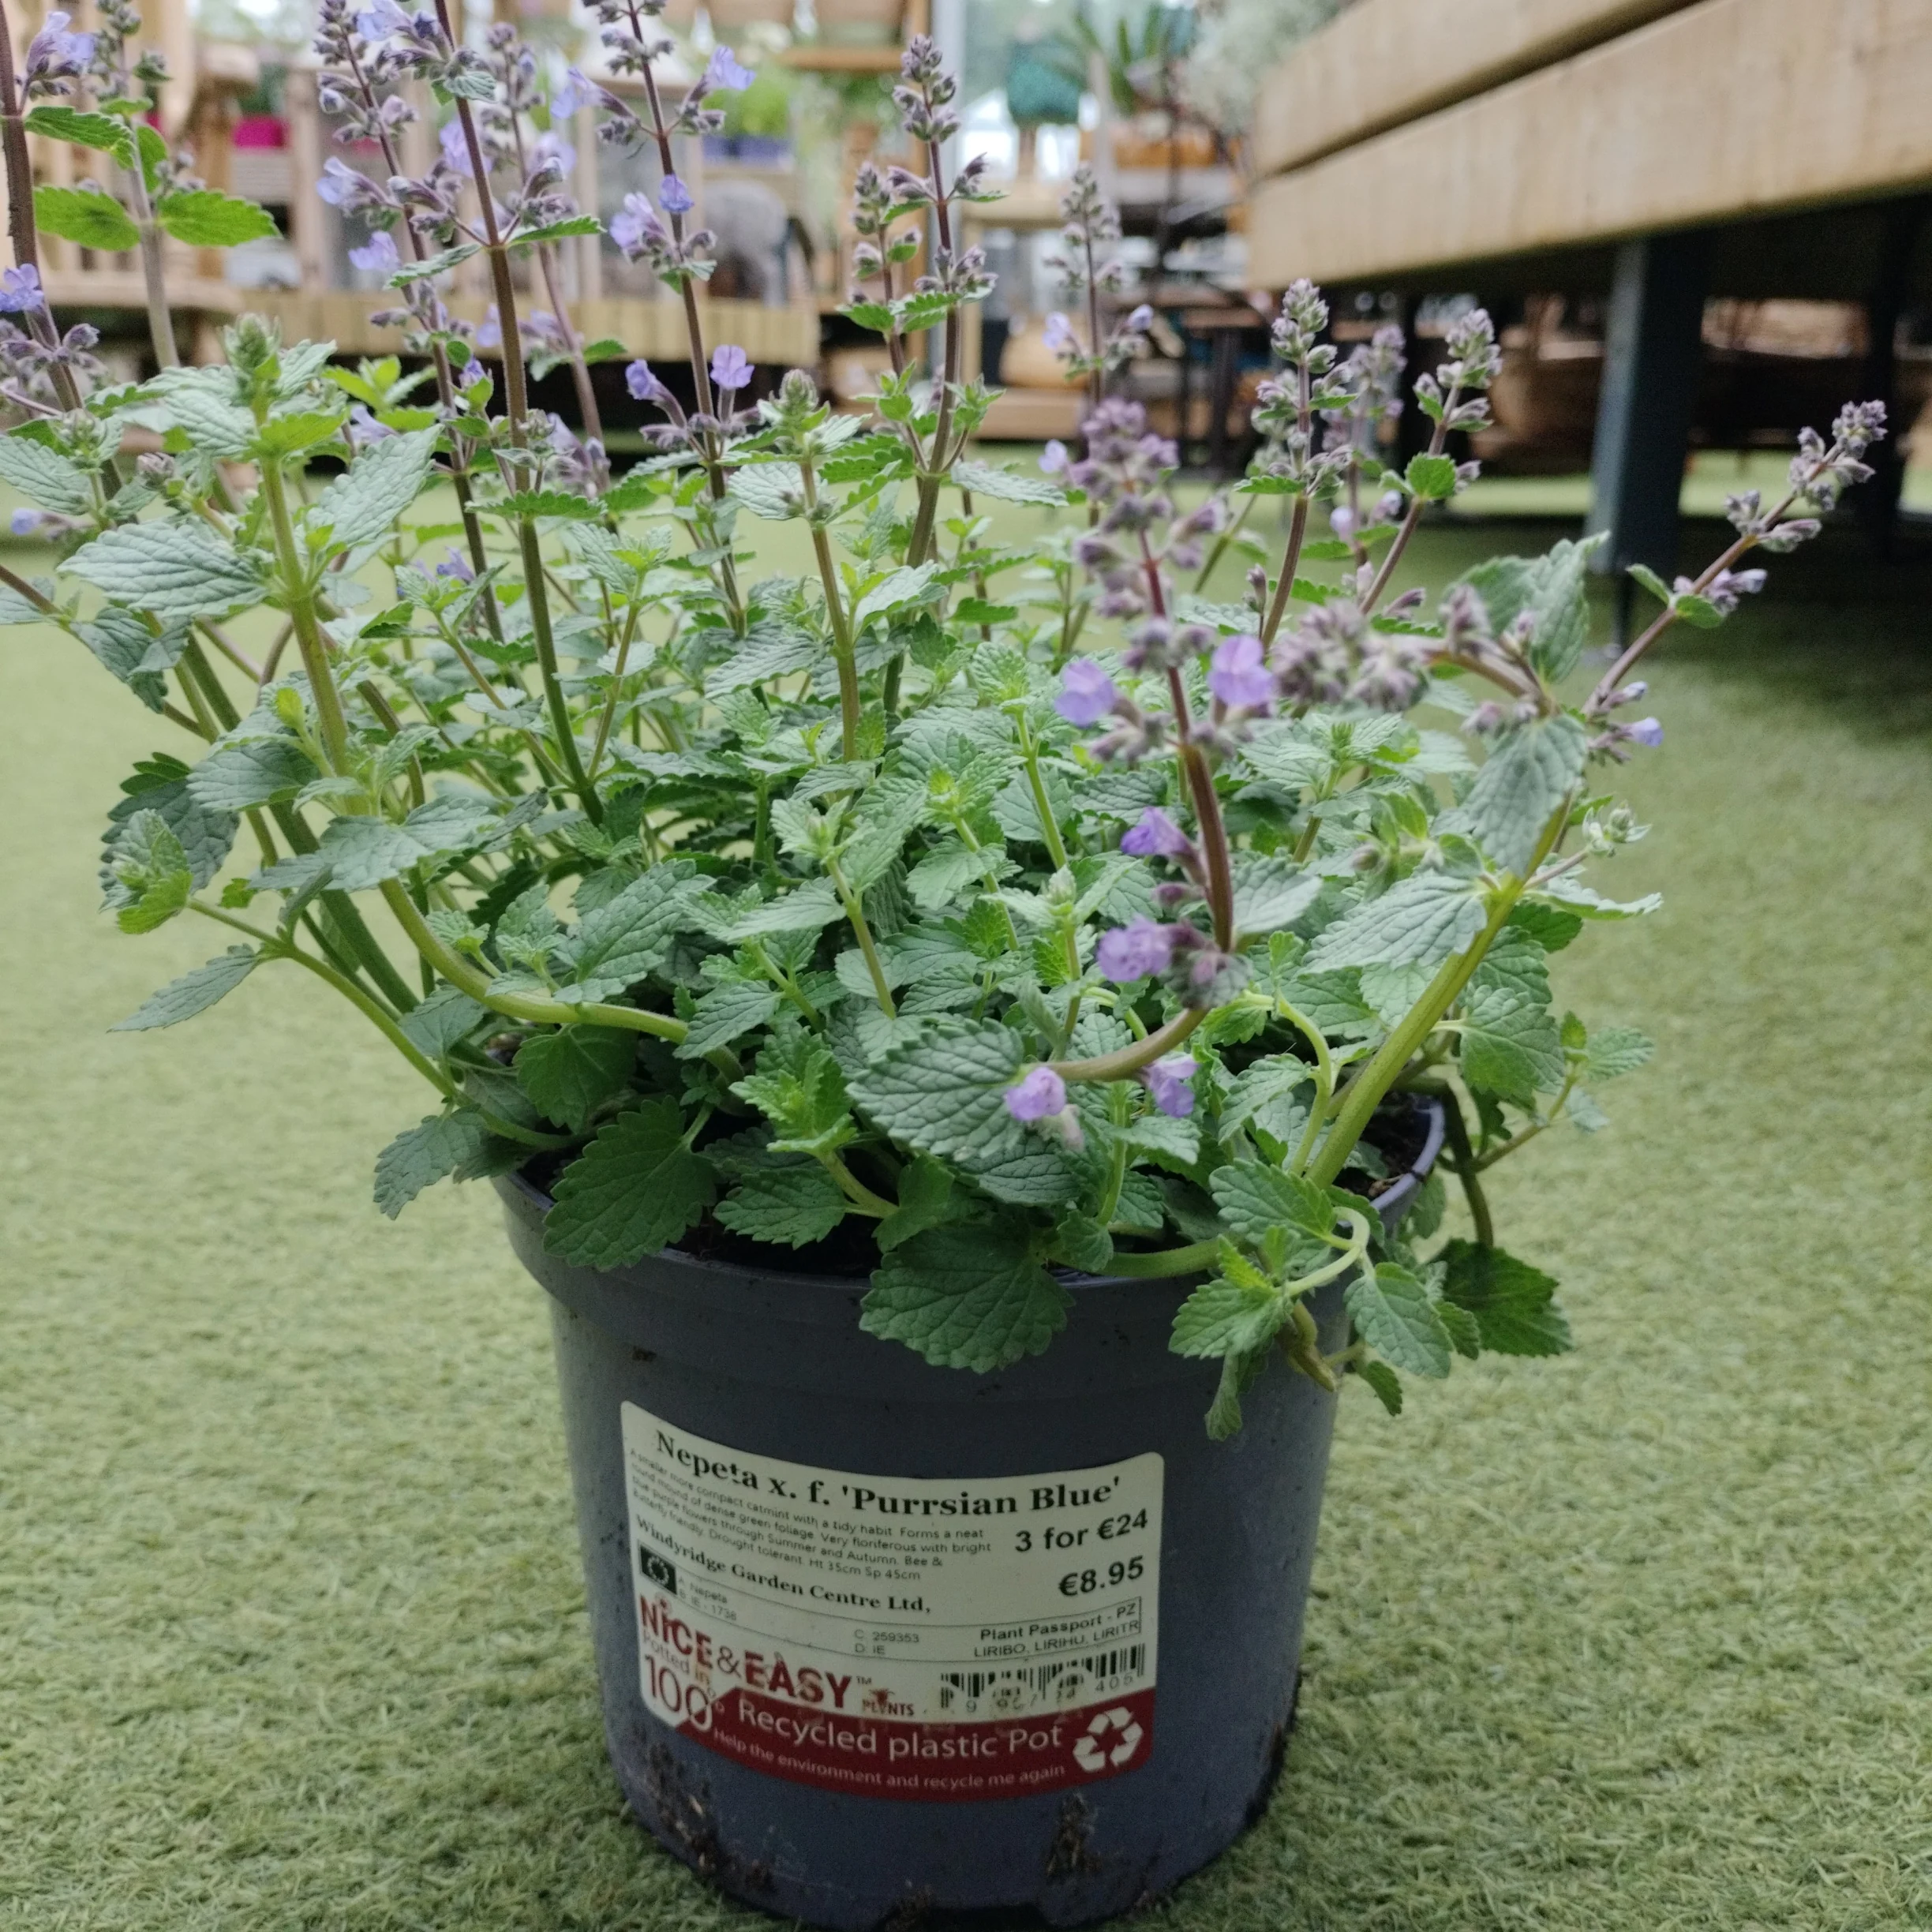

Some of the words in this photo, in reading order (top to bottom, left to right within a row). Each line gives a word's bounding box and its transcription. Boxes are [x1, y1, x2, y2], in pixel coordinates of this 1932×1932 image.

[657, 1429, 758, 1490] Nepeta
[768, 1477, 797, 1500] x.
[808, 1480, 830, 1506] f.
[842, 1484, 1017, 1516] 'Purrsian
[1030, 1475, 1120, 1511] Blue'
[657, 1478, 688, 1501] mound
[704, 1501, 736, 1518] dense
[739, 1513, 771, 1529] green
[821, 1532, 848, 1548] Very
[853, 1537, 916, 1552] floriferous
[921, 1542, 948, 1553] with
[952, 1543, 991, 1556] bright
[670, 1473, 694, 1491] more
[697, 1486, 743, 1508] compact
[747, 1502, 790, 1520] catmint
[793, 1515, 818, 1528] with
[822, 1520, 829, 1529] a
[833, 1520, 857, 1535] tidy
[900, 1527, 940, 1538] Forms
[956, 1529, 983, 1538] neat
[682, 1503, 718, 1526] flowers
[721, 1520, 764, 1541] through
[768, 1533, 817, 1553] Summer
[821, 1548, 843, 1558] and
[904, 1556, 927, 1566] Bee
[932, 1556, 943, 1567] &
[1016, 1530, 1032, 1552] 3
[1043, 1527, 1089, 1550] for
[1096, 1508, 1148, 1541] €24
[637, 1513, 727, 1574] Windyridge
[731, 1563, 803, 1596] Garden
[810, 1584, 882, 1609] Centre
[888, 1596, 931, 1614] Ltd,
[709, 1529, 754, 1552] Drought
[810, 1557, 824, 1569] Ht
[828, 1560, 862, 1575] 35cm
[865, 1566, 882, 1579] Sp
[885, 1568, 921, 1579] 45cm
[1058, 1555, 1144, 1597] €8.95
[872, 1631, 920, 1643] 259353
[980, 1626, 1024, 1641] Plant
[1028, 1614, 1103, 1637] Passport
[1117, 1602, 1136, 1619] PZ
[1093, 1619, 1140, 1642] LIRITR
[713, 1727, 747, 1754] Help
[750, 1743, 774, 1762] the
[777, 1754, 882, 1785] environment
[887, 1774, 919, 1788] and
[924, 1774, 984, 1792] recycle
[988, 1774, 1015, 1785] me
[1020, 1765, 1065, 1784] again
[739, 1697, 877, 1754] Recycled
[889, 1732, 998, 1762] plastic
[1009, 1725, 1063, 1754] Pot
